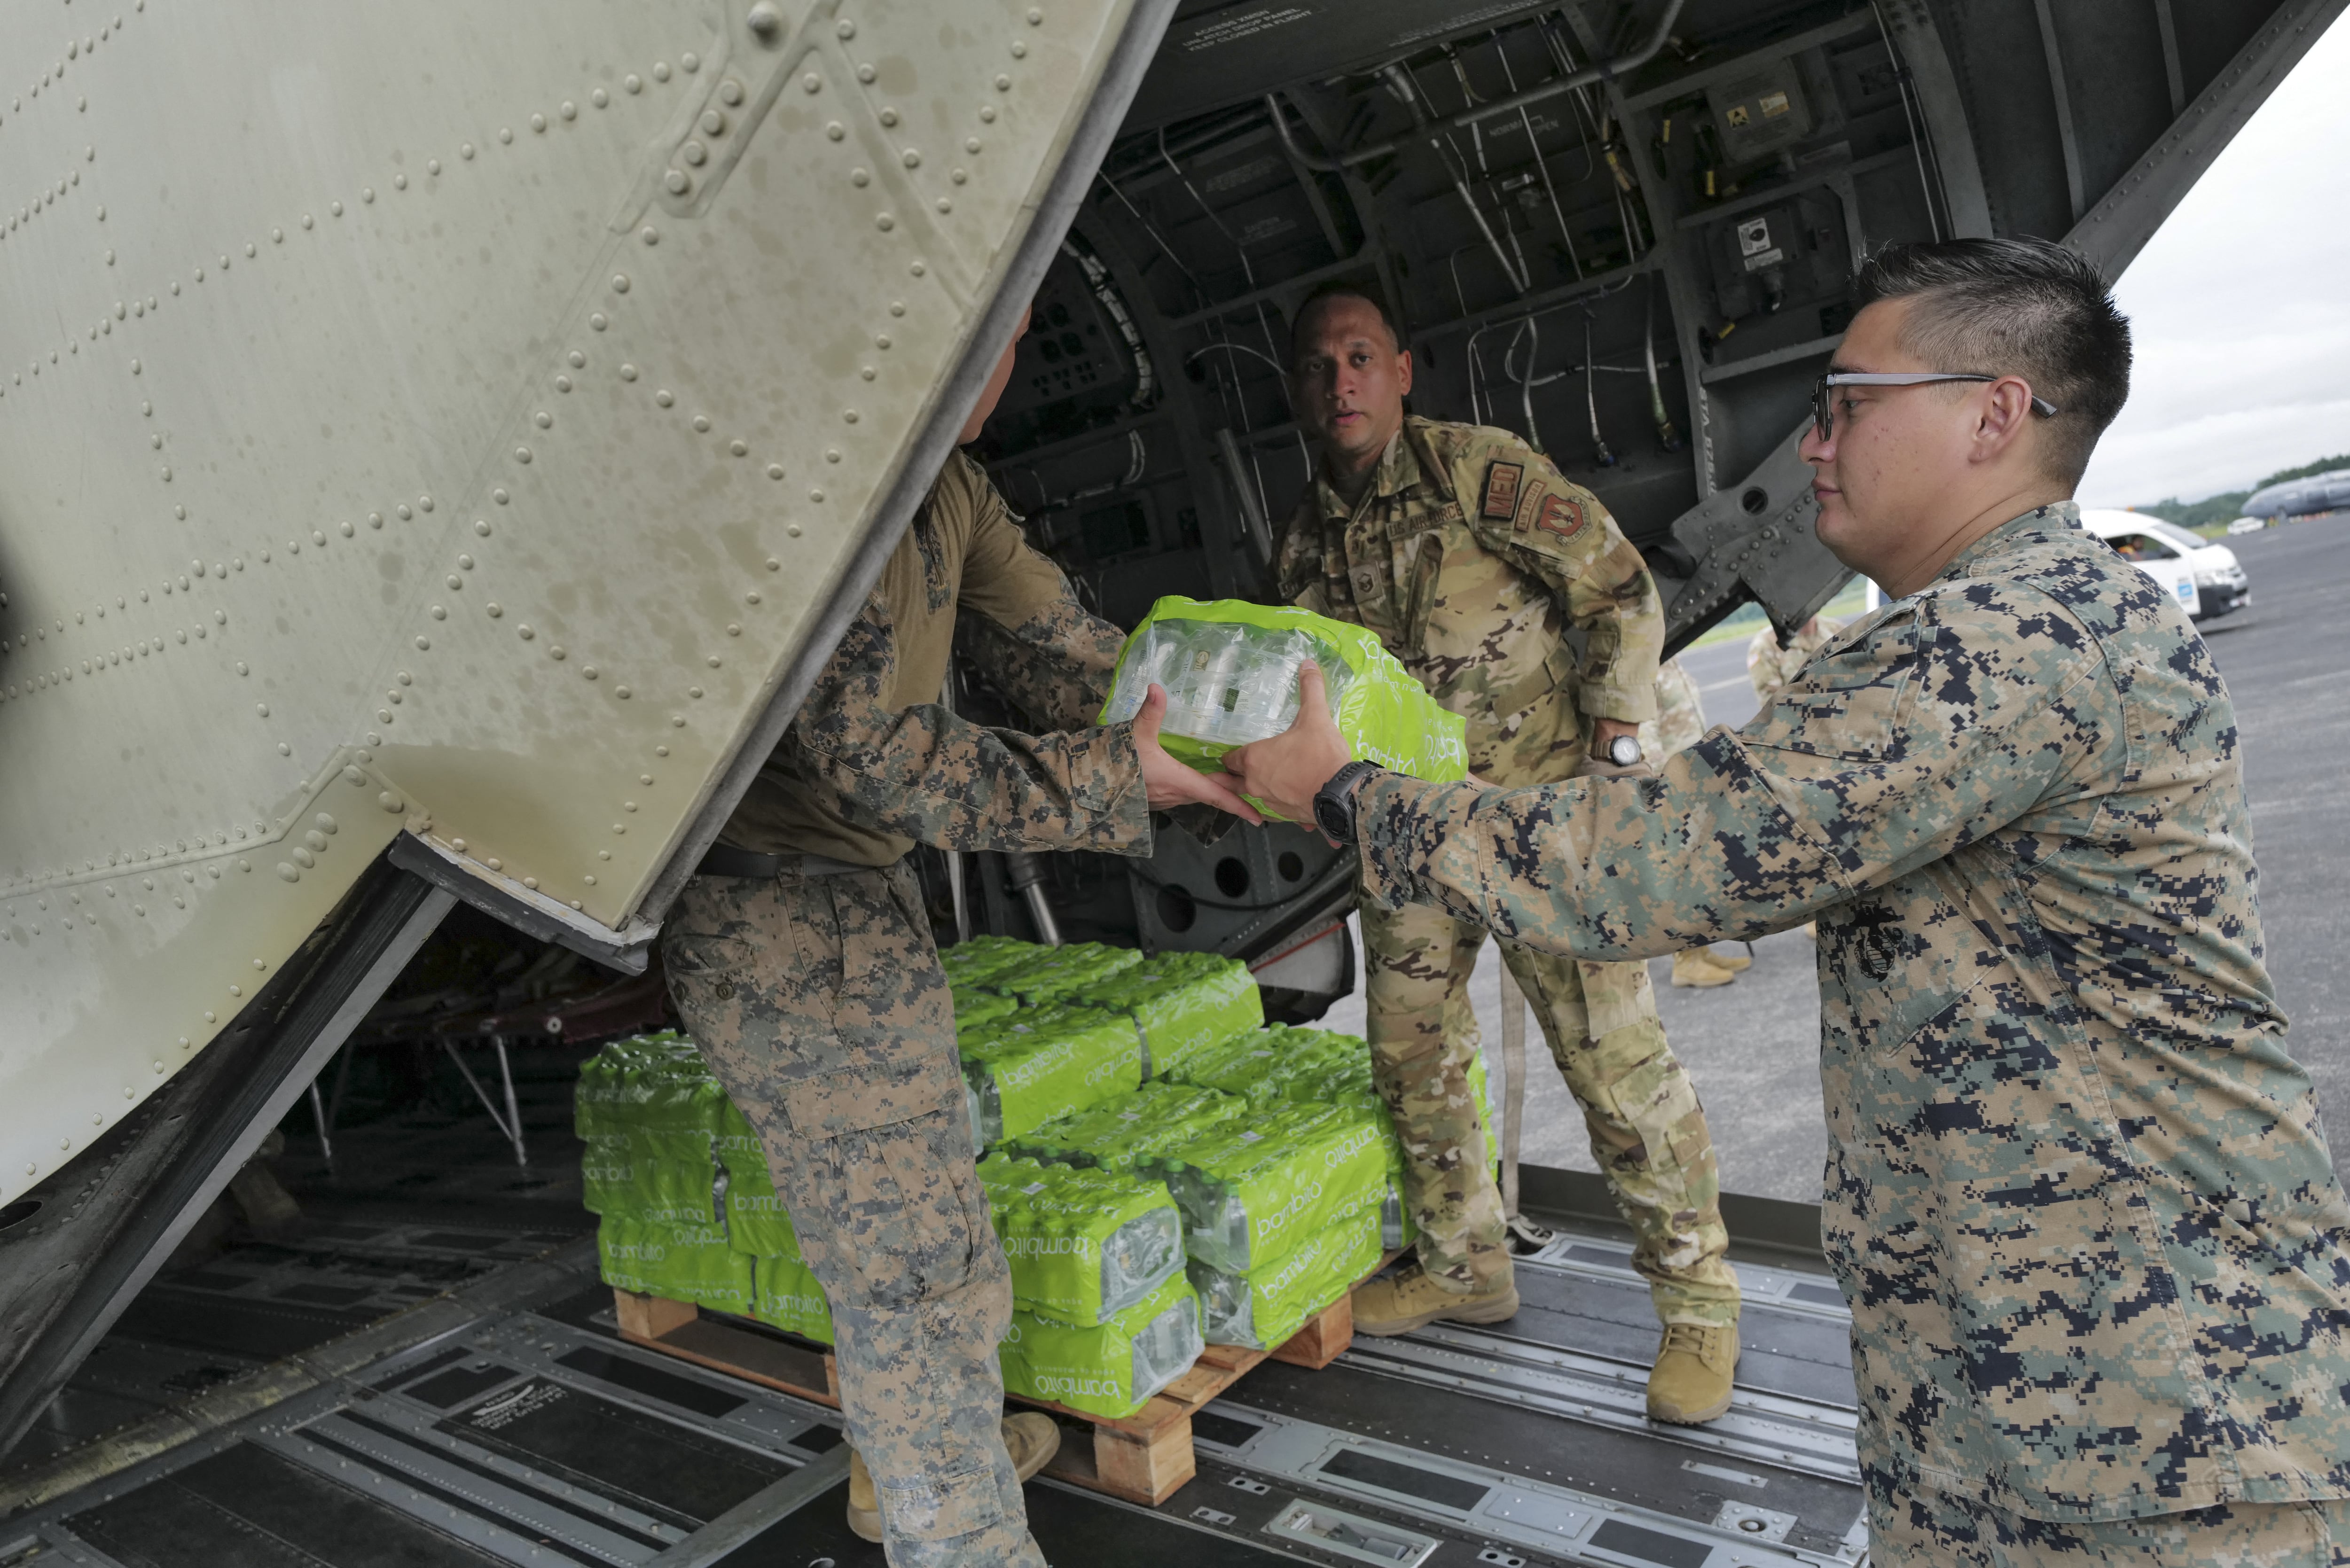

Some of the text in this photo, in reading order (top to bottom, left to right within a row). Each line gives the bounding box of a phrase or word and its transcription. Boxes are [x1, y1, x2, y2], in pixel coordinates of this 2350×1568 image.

[1485, 468, 1517, 514] MED
[1519, 483, 1541, 526] AIR ADVISOR
[1388, 503, 1464, 537] US AIR FORCE
[1002, 1043, 1070, 1085] bambito
[1159, 1028, 1212, 1072] bambito
[734, 1191, 787, 1211] bamb
[1256, 1180, 1322, 1237] bambito
[1003, 1236, 1089, 1261] bambito
[1259, 1238, 1322, 1301] bambito
[1035, 1375, 1121, 1399] bambito
